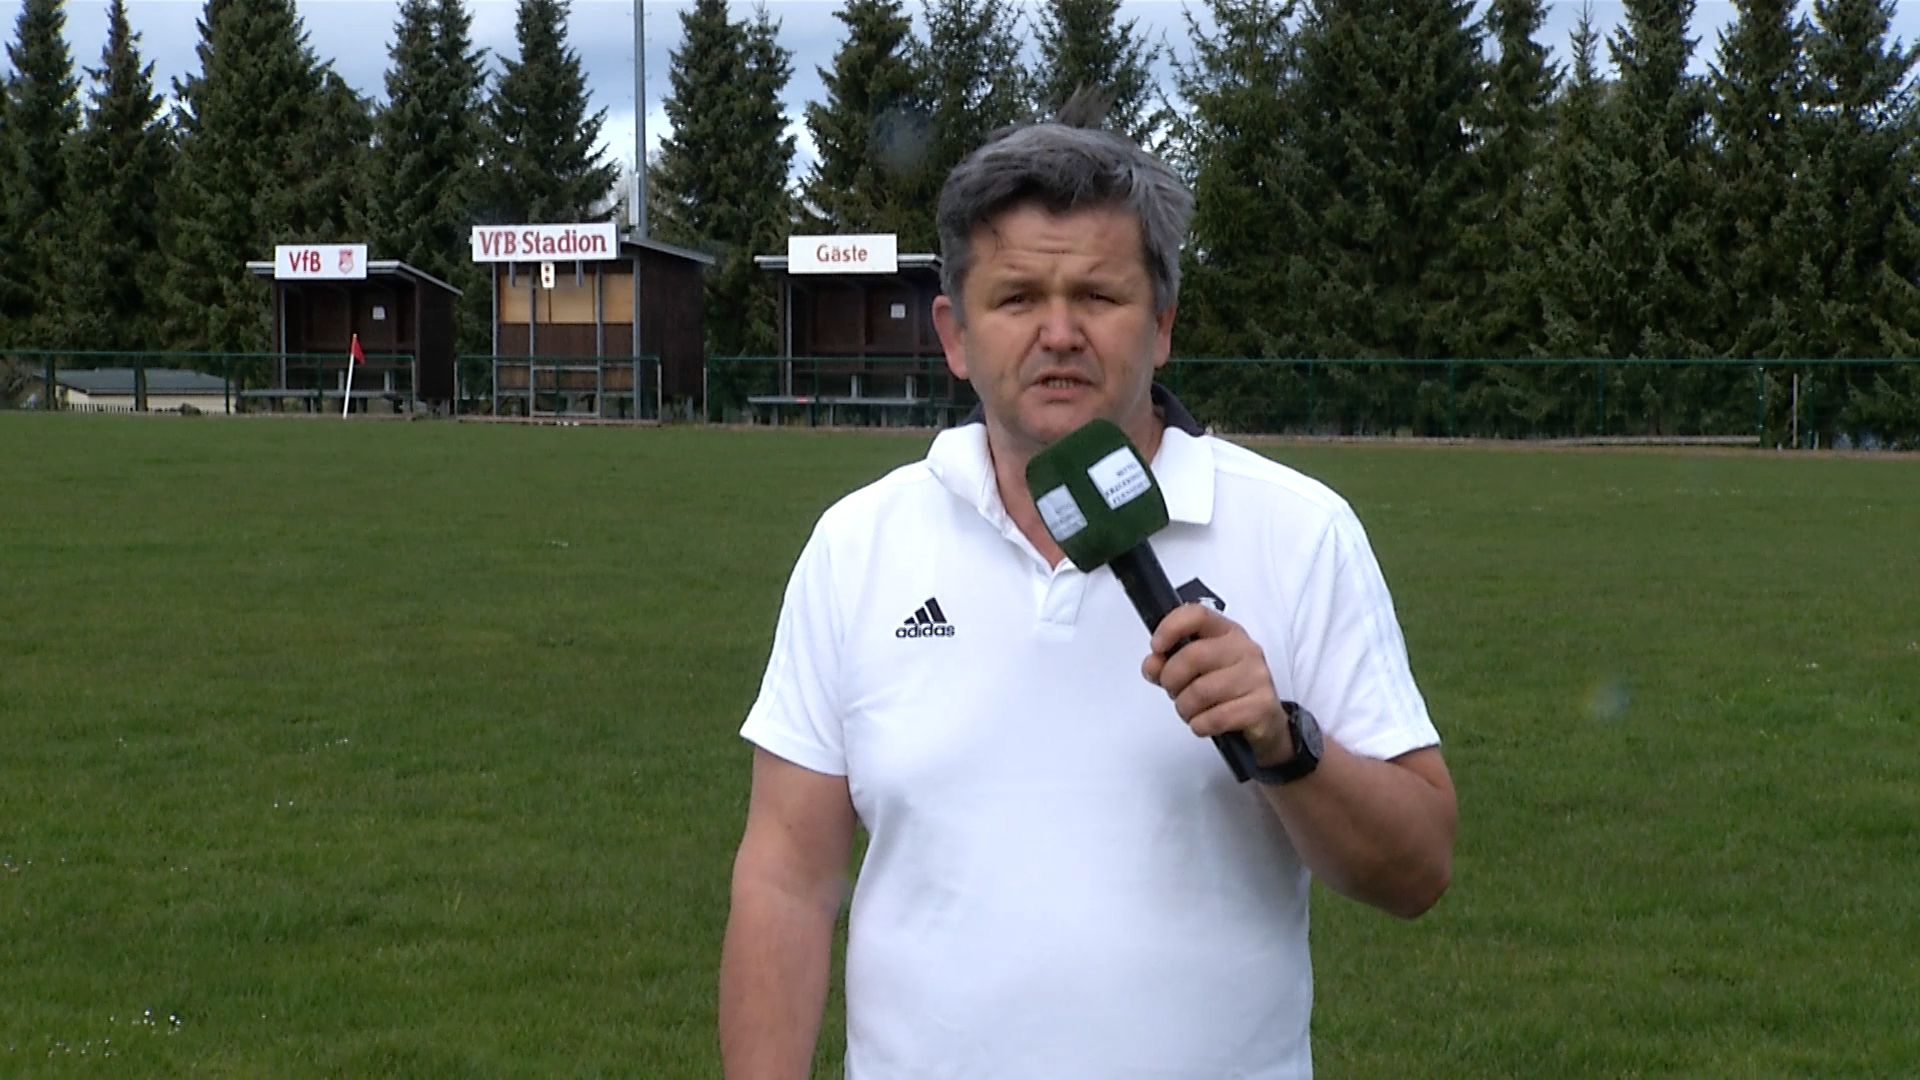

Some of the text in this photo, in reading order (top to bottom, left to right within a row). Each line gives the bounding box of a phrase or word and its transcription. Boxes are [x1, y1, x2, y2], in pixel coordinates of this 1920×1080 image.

[477, 229, 607, 256] VfB Stadion
[816, 243, 868, 262] Gäste
[288, 249, 321, 272] VfB
[895, 622, 955, 638] adidas
